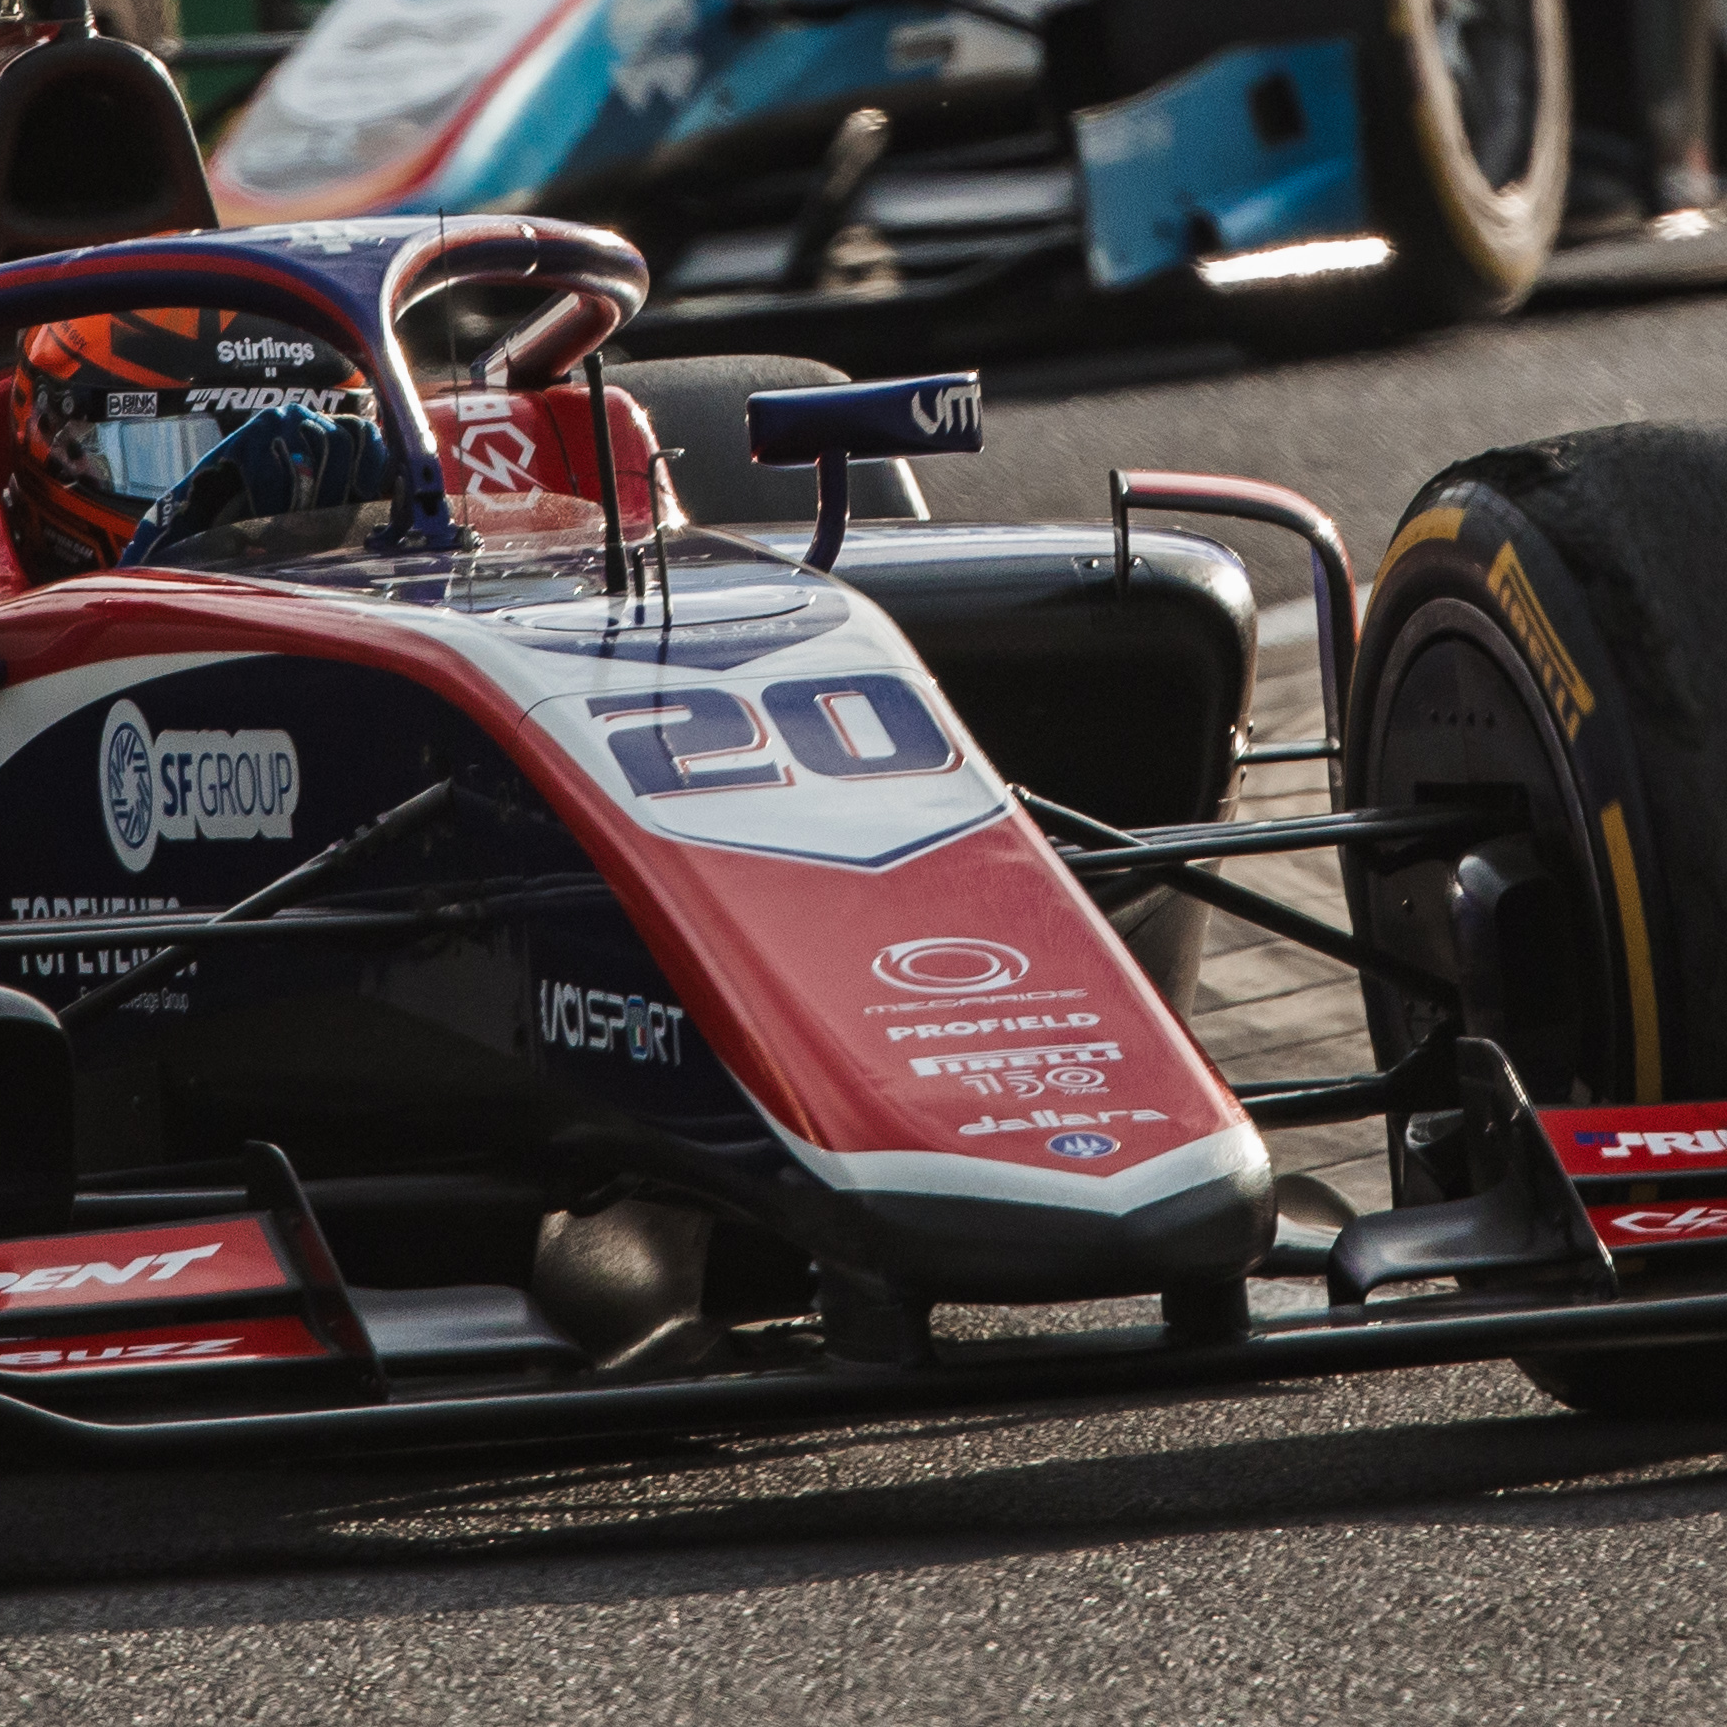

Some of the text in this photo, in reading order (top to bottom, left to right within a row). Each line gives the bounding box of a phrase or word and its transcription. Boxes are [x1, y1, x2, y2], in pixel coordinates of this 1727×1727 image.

[217, 337, 315, 365] Stirlings
[123, 394, 155, 408] BINK
[185, 387, 346, 413] TRIDENT
[585, 675, 966, 799] 20
[887, 1012, 1102, 1043] PROFIELD
[909, 1042, 1123, 1077] PIRELLI
[959, 1067, 1105, 1099] 150
[958, 1109, 1170, 1136] dallara
